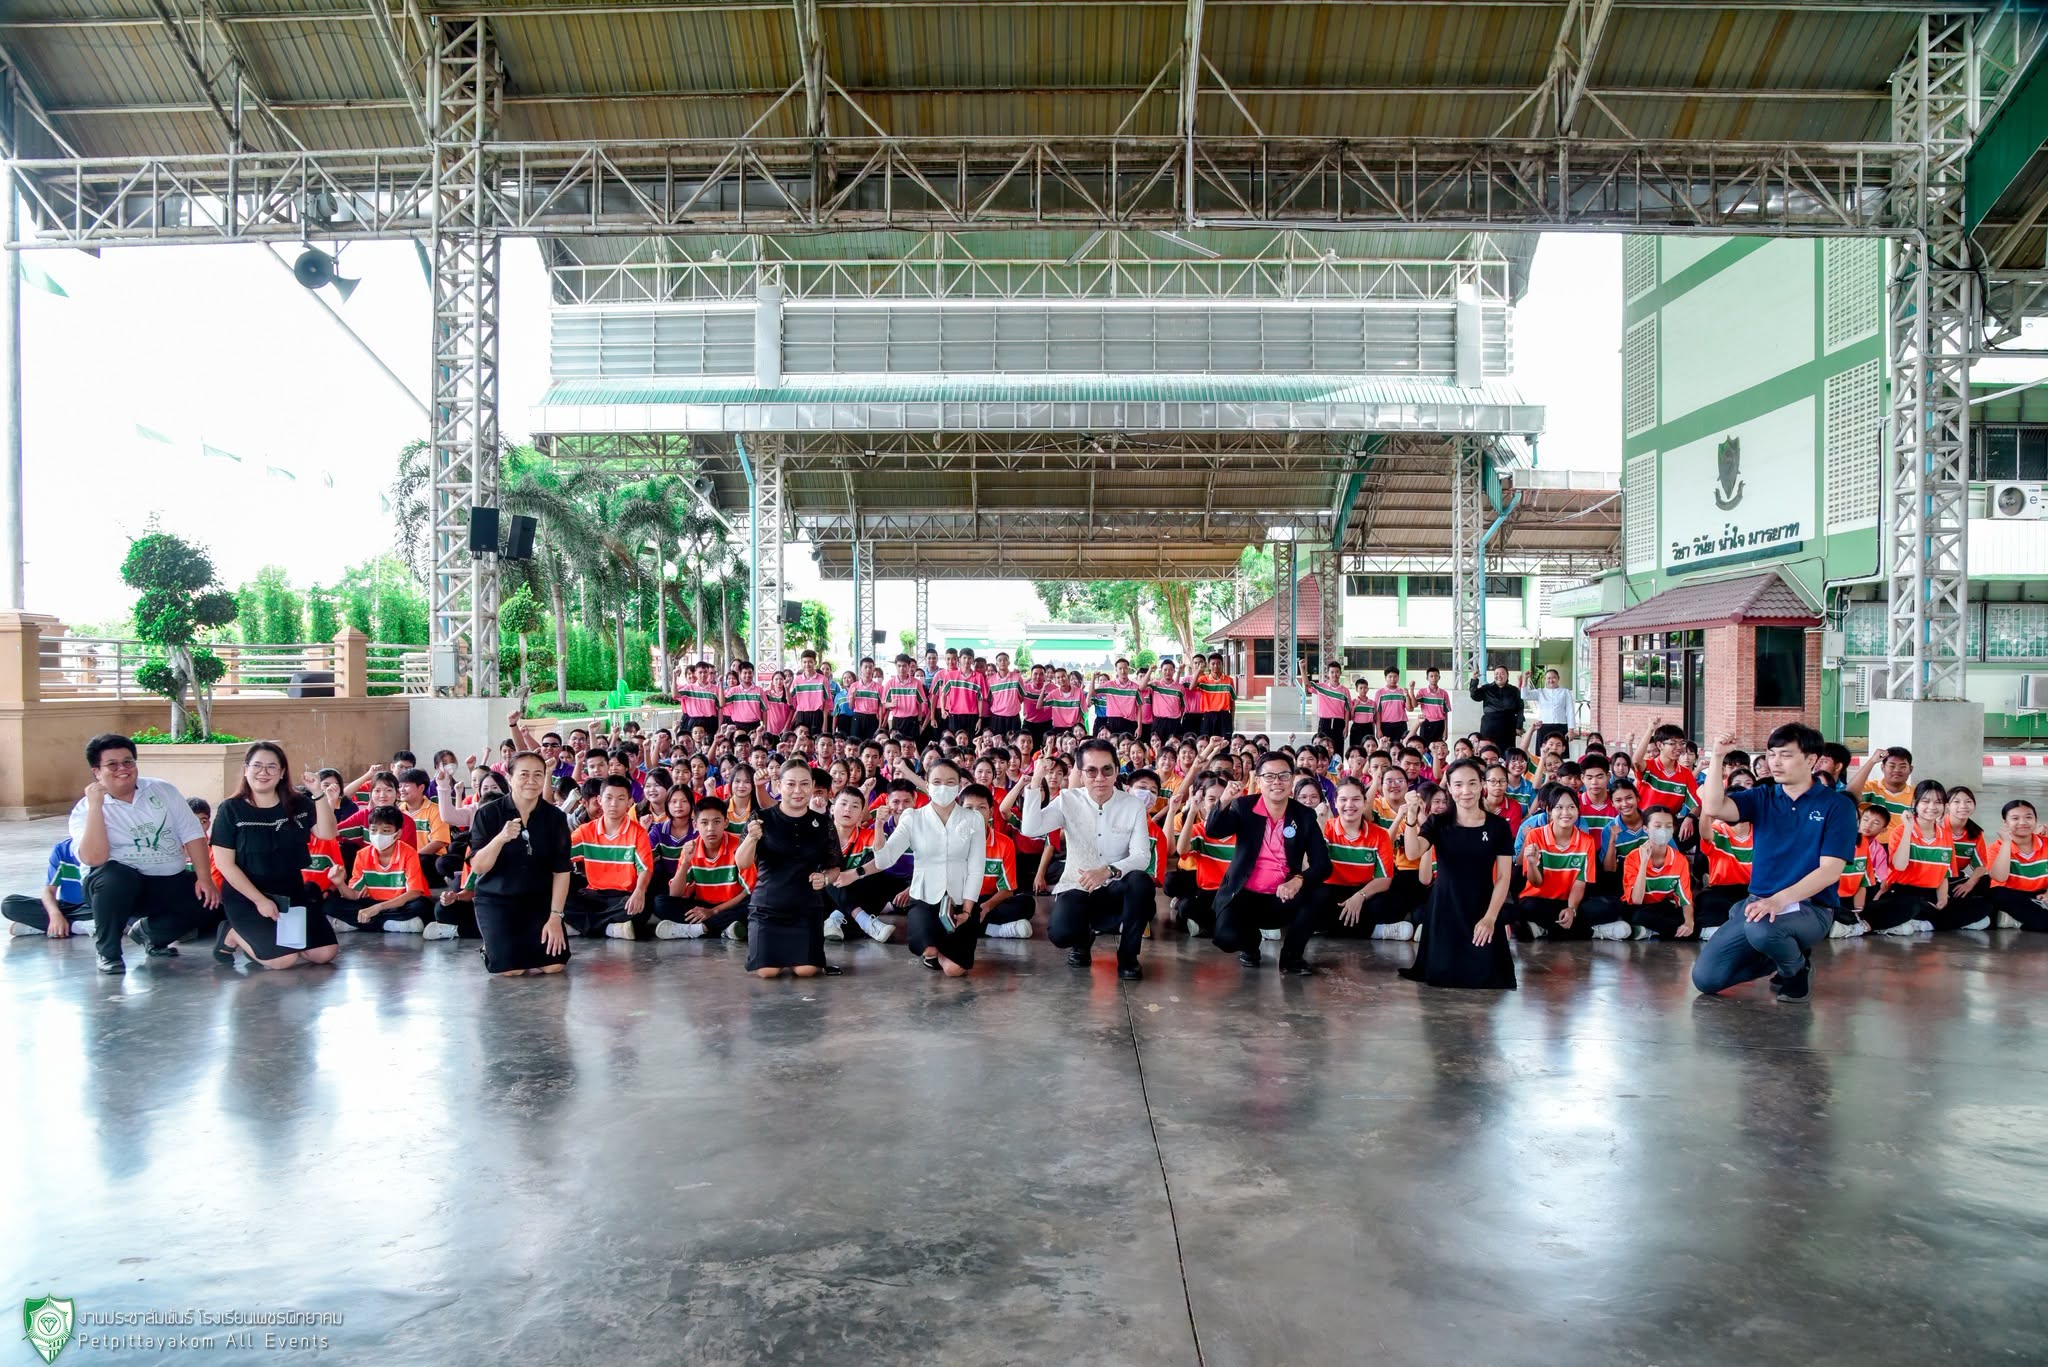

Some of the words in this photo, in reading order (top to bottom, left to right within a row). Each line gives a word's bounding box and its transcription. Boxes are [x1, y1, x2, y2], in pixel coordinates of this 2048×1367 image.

[1671, 542, 1690, 561] วิชา
[1692, 534, 1715, 557] วินัย
[1718, 522, 1745, 551] น้ำใจ
[1749, 522, 1800, 545] มารยาท
